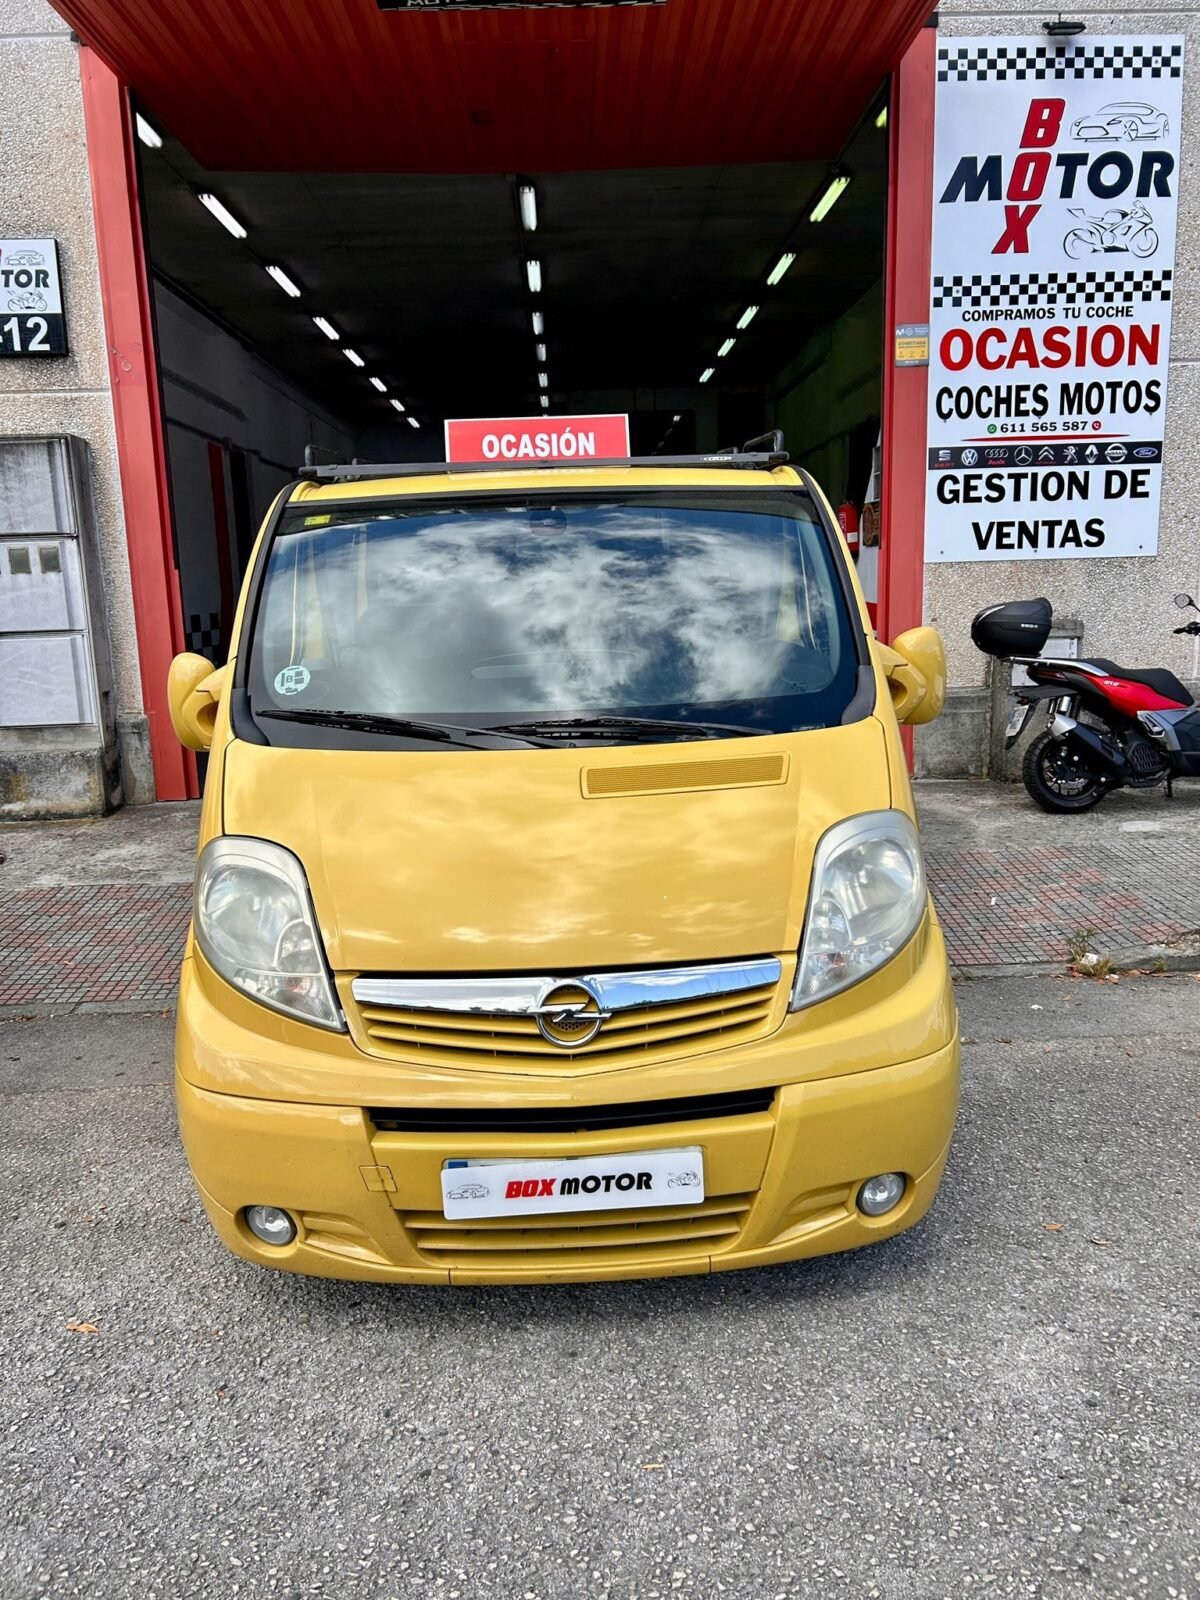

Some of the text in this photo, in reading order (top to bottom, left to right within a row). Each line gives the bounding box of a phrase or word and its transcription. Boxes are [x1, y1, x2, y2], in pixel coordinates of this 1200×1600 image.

[939, 150, 1175, 203] MOTOR
[991, 98, 1066, 254] BOX
[962, 306, 1134, 322] COMPRAMOS TU COCHE
[0, 316, 51, 352] 12
[939, 324, 1160, 372] OCASION
[935, 379, 1162, 420] COCHES MOTOS
[481, 427, 596, 459] OCASIÓN
[1000, 421, 1088, 433] 611 565 587
[936, 469, 1151, 505] GESTION DE
[971, 518, 1105, 551] VENTAS
[505, 1171, 653, 1199] BOX MOTOR
